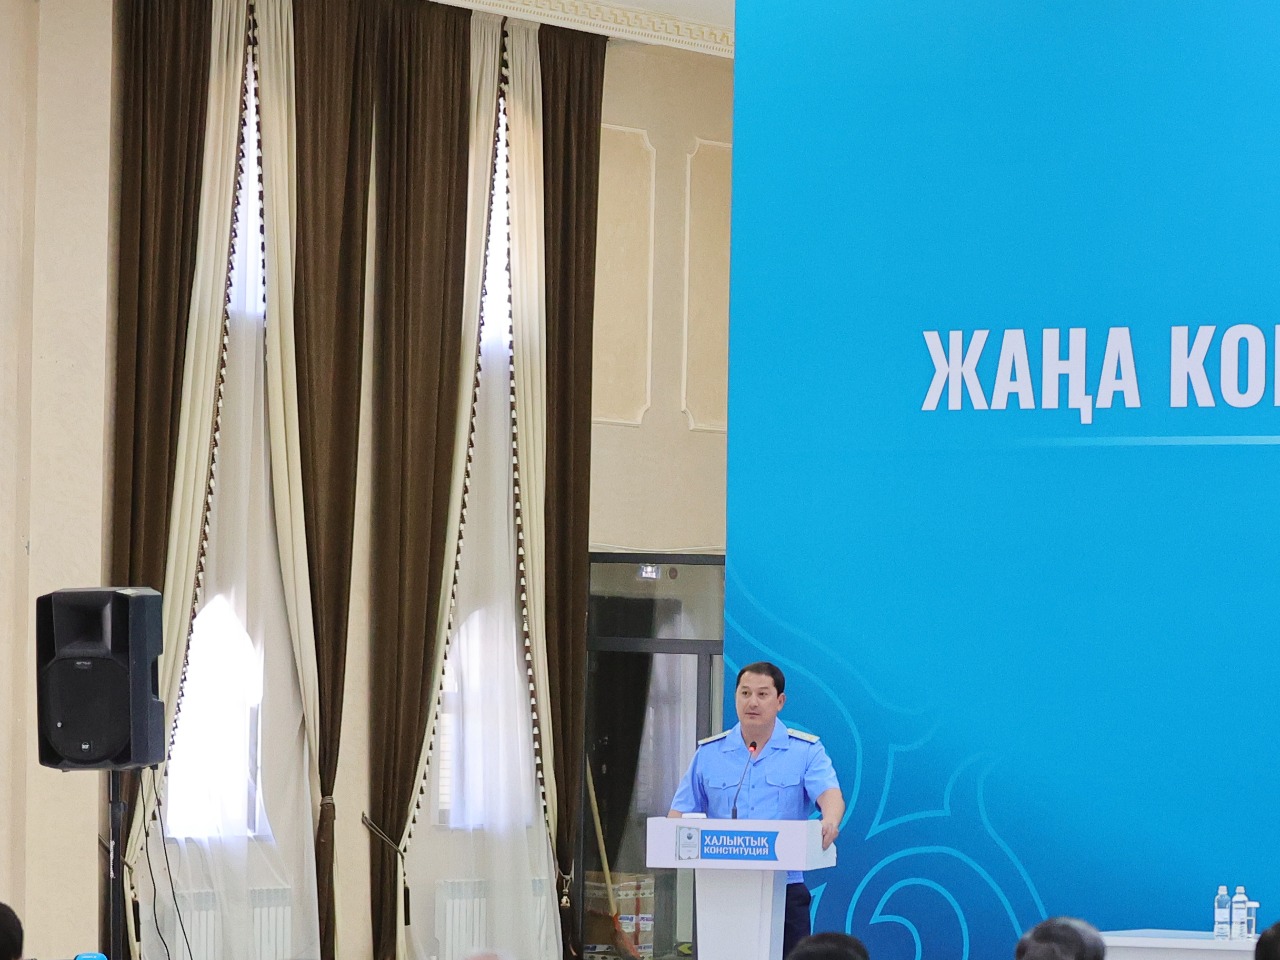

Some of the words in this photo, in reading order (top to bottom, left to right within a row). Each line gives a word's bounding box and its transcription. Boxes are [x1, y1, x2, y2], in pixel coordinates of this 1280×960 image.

[922, 326, 1141, 425] ЖАҢА
[704, 835, 769, 848] ХАЛЫҚТЫҚ
[704, 846, 769, 855] КОНСТИТУЦИЯ
